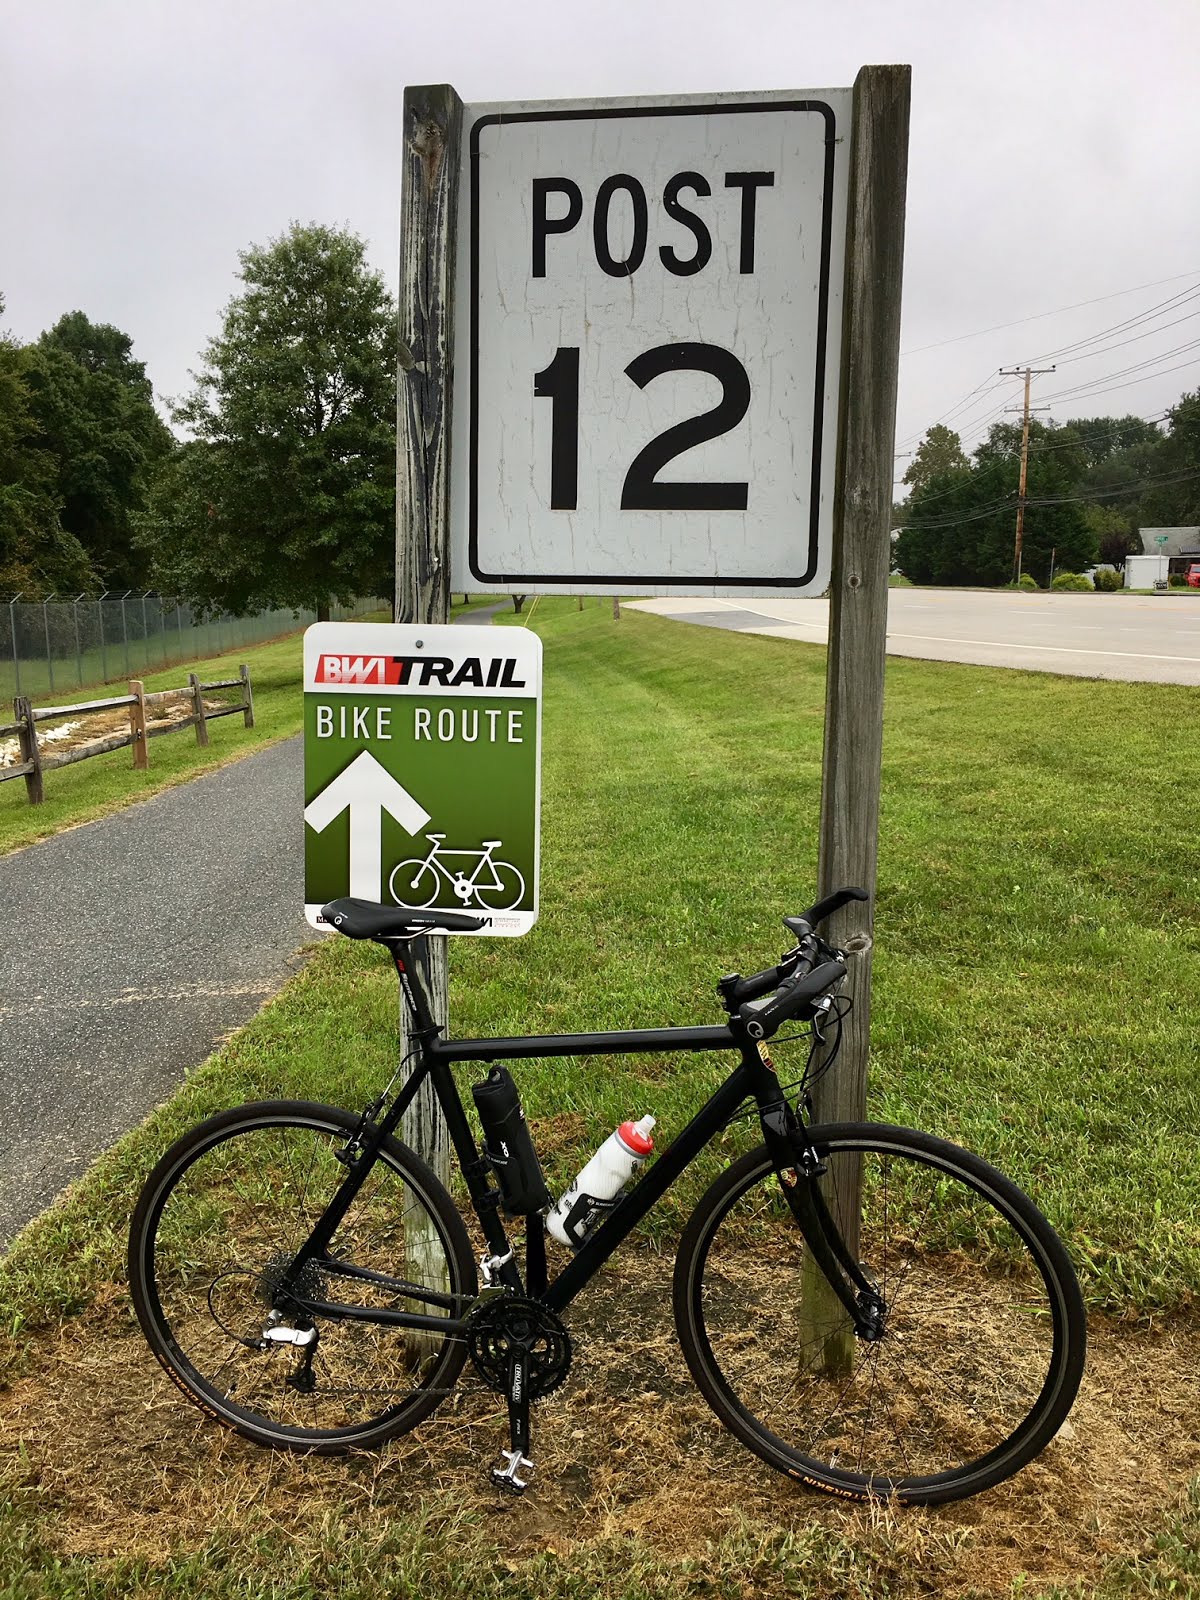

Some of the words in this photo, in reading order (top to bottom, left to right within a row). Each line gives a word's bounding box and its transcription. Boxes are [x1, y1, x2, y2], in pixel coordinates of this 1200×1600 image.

[533, 171, 774, 278] POST
[534, 342, 750, 510] 12
[323, 656, 386, 684] BWI
[393, 656, 526, 688] TRAIL
[316, 705, 392, 740] BIKE
[414, 708, 523, 743] ROUTE
